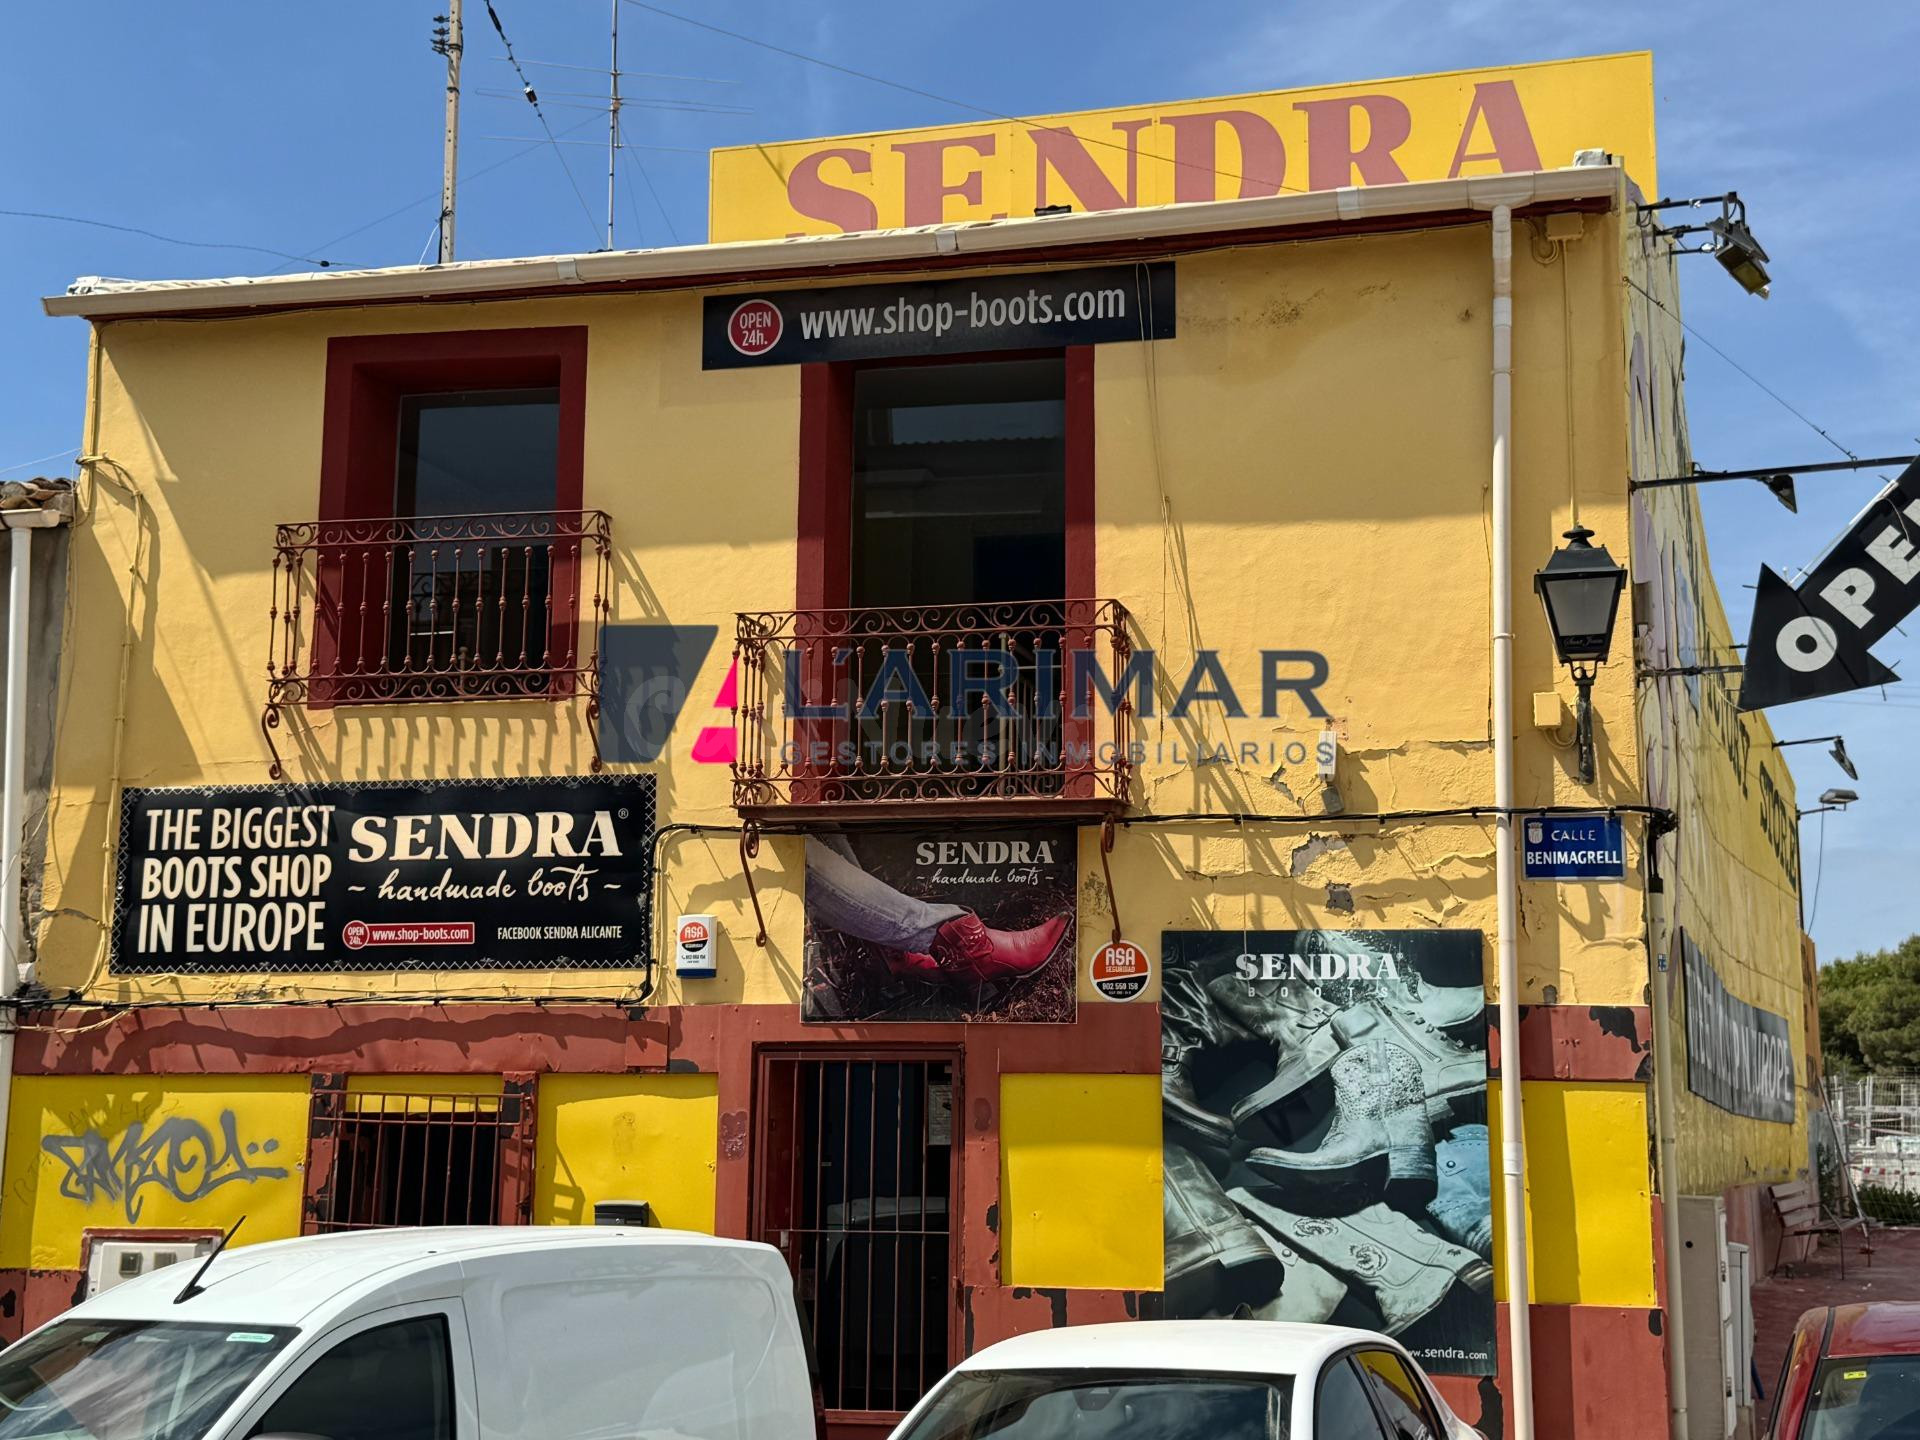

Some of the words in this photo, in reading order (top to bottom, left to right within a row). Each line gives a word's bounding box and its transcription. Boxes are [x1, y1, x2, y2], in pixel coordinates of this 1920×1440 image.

[785, 80, 1544, 238] SENDRA
[739, 311, 772, 328] OPEN
[800, 288, 1126, 340] www.shop-boots.com
[741, 329, 768, 347] 24h.
[1776, 498, 1920, 672] OPE
[146, 809, 201, 851] THE
[210, 805, 335, 850] BIGGEST
[1551, 829, 1597, 842] CALLE
[915, 840, 1054, 866] SENDRA
[1526, 850, 1621, 865] BENIMAGRELL
[142, 856, 242, 900] BOOTS
[249, 853, 333, 898] SHOP
[377, 867, 517, 901] handmade
[528, 862, 599, 901] boots
[931, 868, 1002, 885] handmade
[1006, 867, 1040, 885] boots
[137, 904, 175, 953] IN
[186, 902, 325, 952] EUROPE
[348, 926, 365, 937] OPEN
[372, 927, 470, 942] www.shop-boots.com
[497, 926, 542, 940] FACEBOOK
[543, 926, 579, 939] SENDRA
[580, 925, 623, 939] ALICANTE
[684, 926, 704, 940] ASA
[1105, 947, 1136, 966] ASA
[1235, 953, 1400, 981] SENDRA
[1247, 986, 1390, 999] BOOTS
[1408, 1347, 1488, 1360] ww.sendra.com
